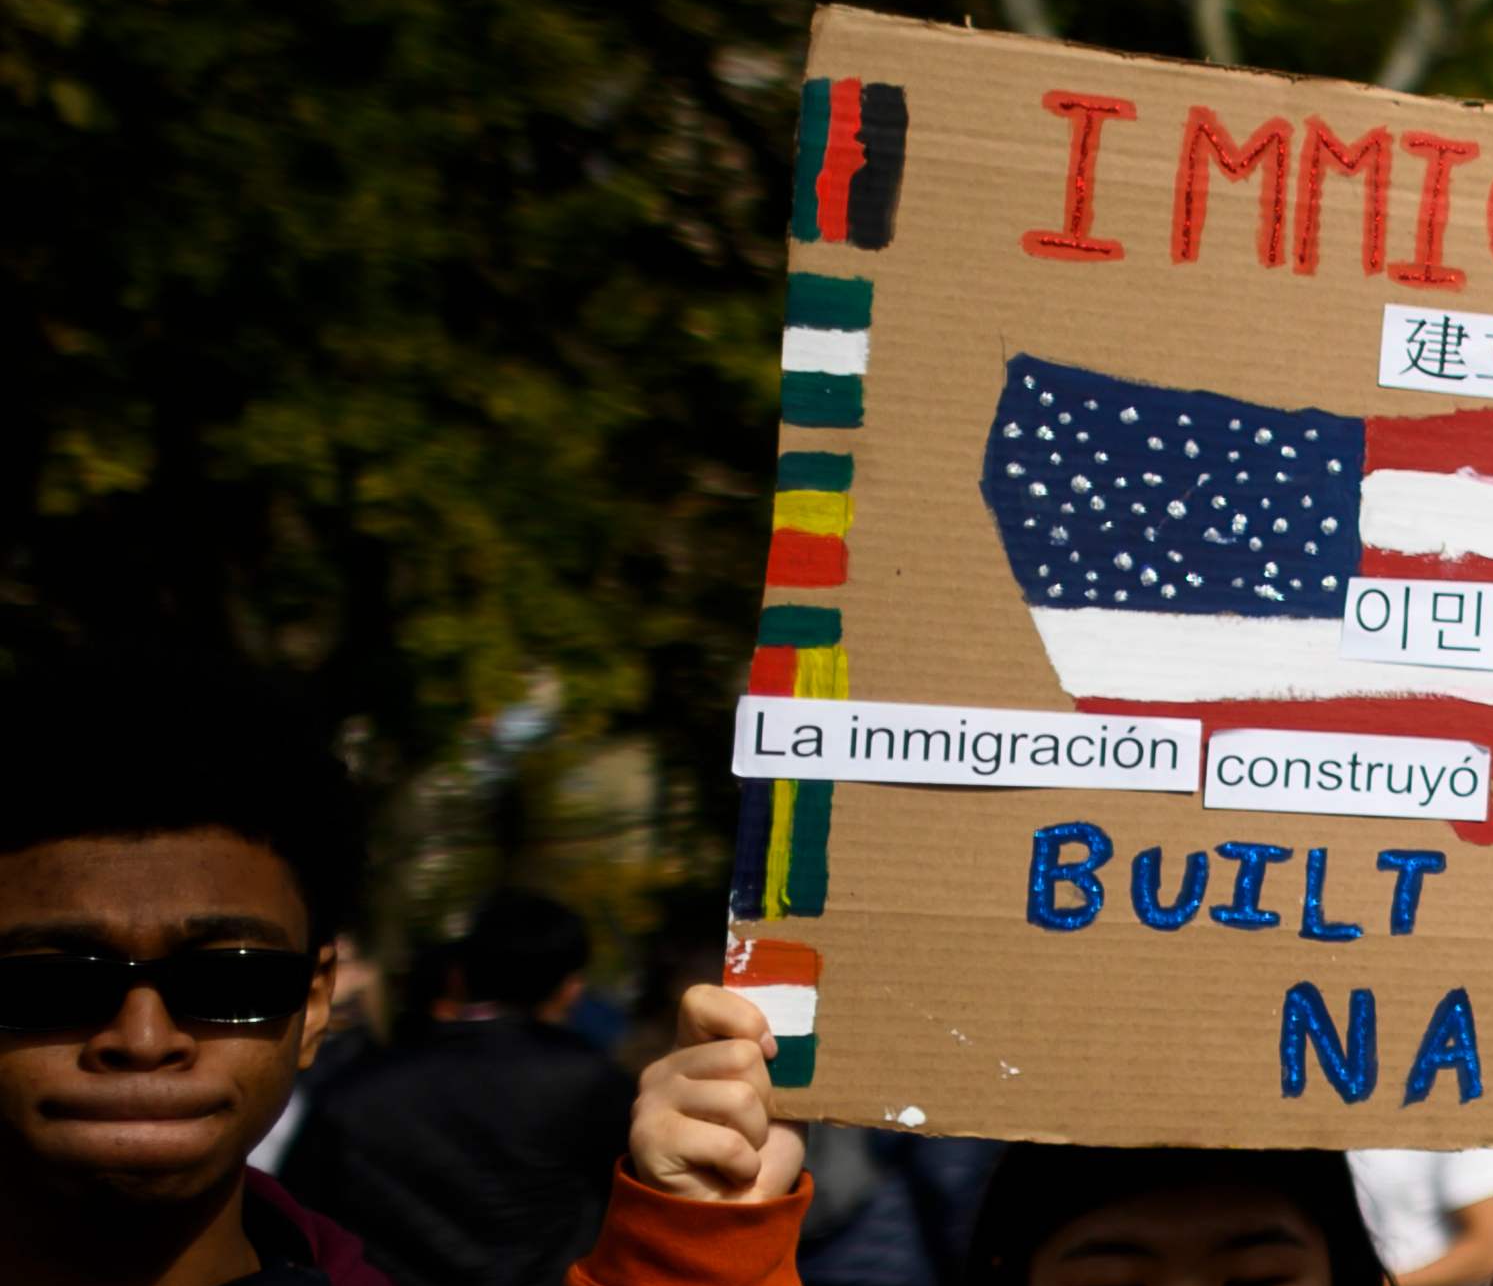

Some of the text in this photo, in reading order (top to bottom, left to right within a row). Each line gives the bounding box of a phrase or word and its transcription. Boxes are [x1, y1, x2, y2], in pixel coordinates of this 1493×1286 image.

[753, 710, 825, 759] La
[849, 713, 1179, 777] inmigración
[1216, 747, 1479, 808] construyó
[1028, 821, 1446, 942] BUILT
